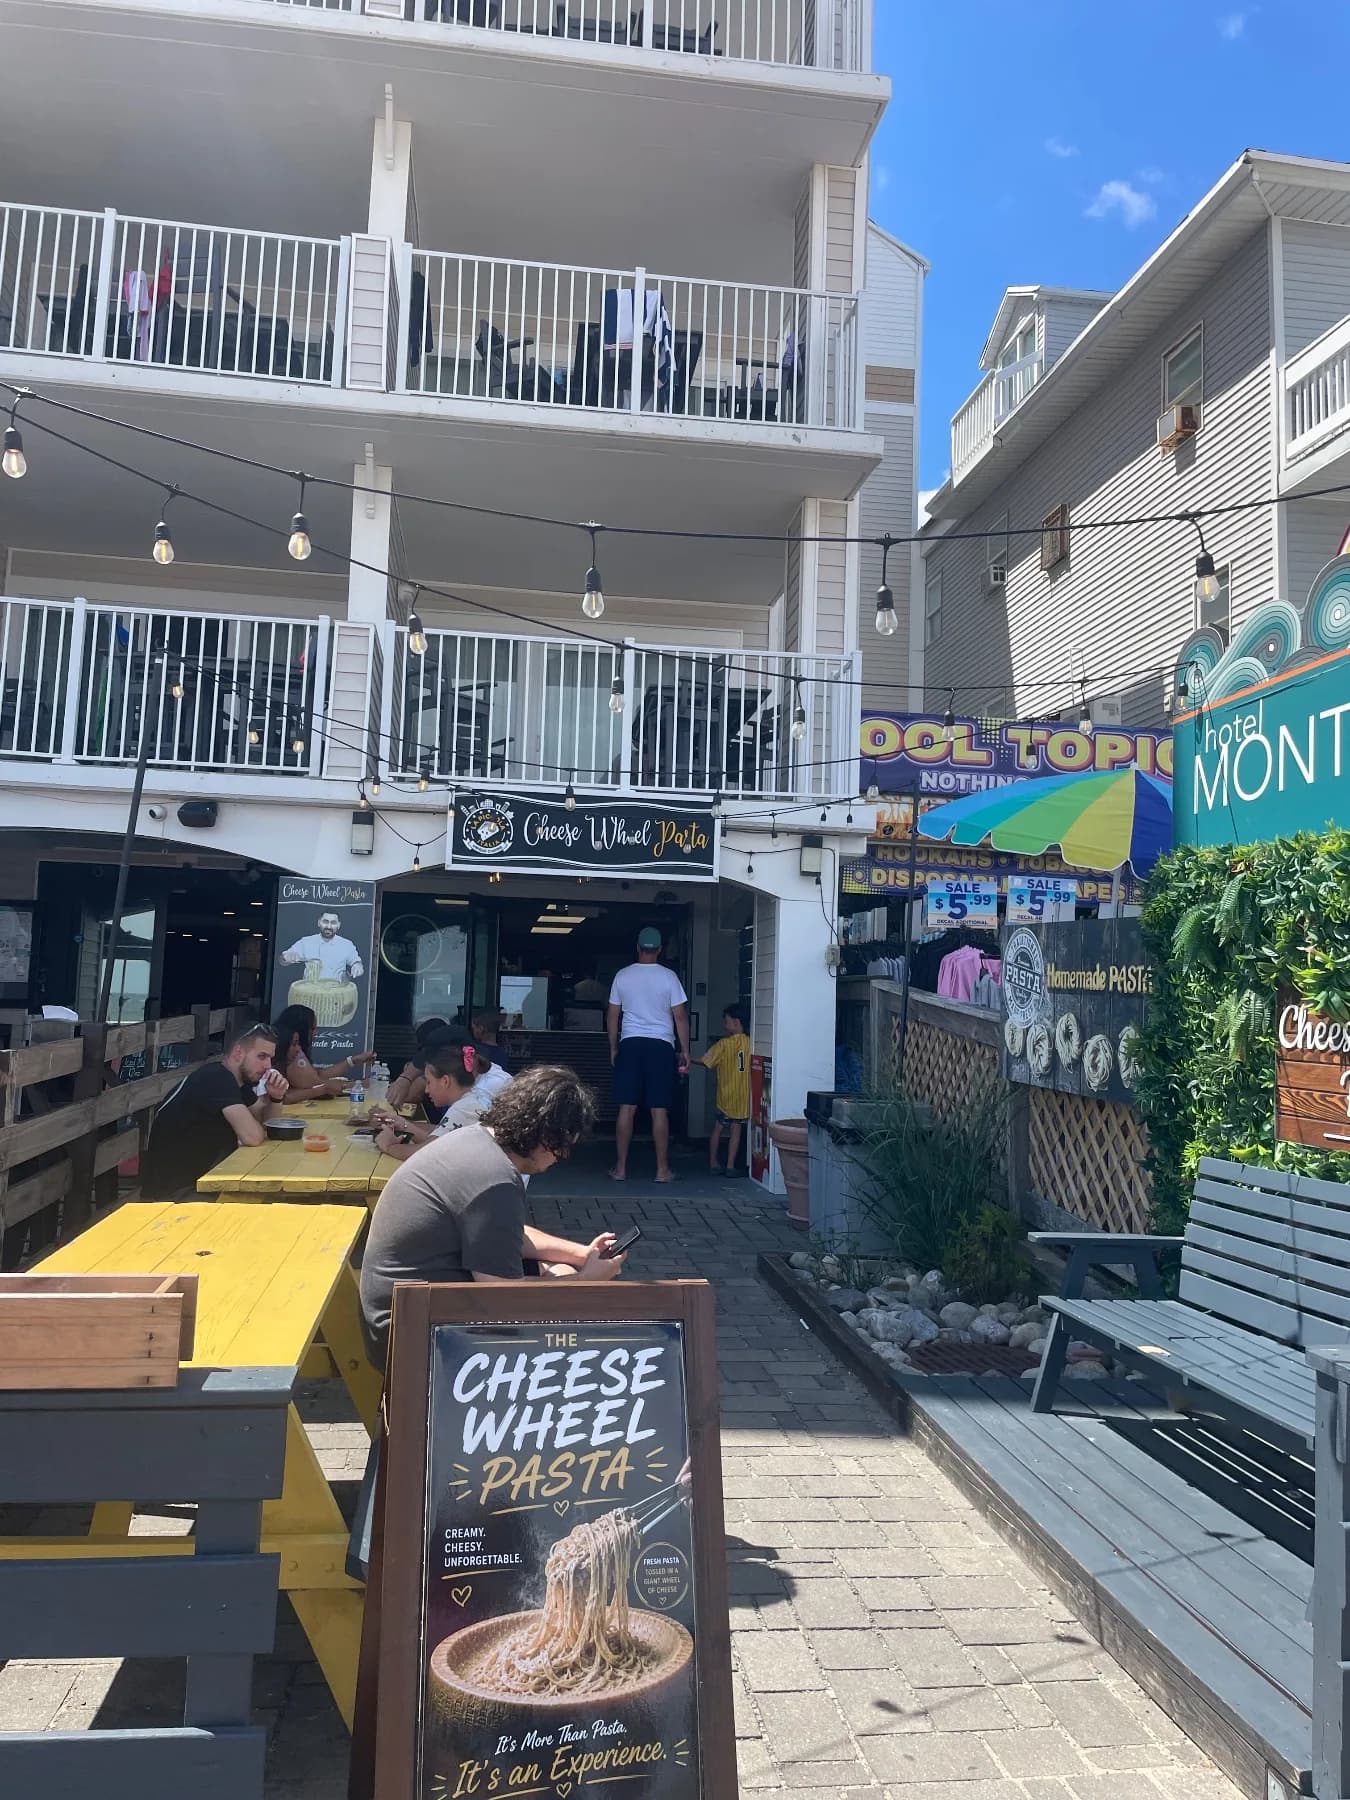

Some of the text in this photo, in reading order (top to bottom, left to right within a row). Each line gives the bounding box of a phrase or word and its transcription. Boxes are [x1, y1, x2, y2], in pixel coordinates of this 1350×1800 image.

[1205, 699, 1263, 753] hotel
[1193, 703, 1350, 815] MONT
[523, 812, 583, 848] Cheese
[282, 883, 366, 902] Cheese Wheel Pasta
[946, 882, 981, 894] SALE
[1027, 879, 1061, 891] SALE
[1006, 964, 1041, 993] PASTA
[1046, 963, 1106, 991] Homemade
[331, 1040, 354, 1049] Pasta
[738, 1051, 745, 1072] 1
[545, 1334, 578, 1347] THE
[452, 1347, 666, 1404] CHEESE
[462, 1397, 657, 1455] WHEEL
[479, 1447, 635, 1505] PASTA
[445, 1527, 486, 1540] CREAMY.
[444, 1541, 485, 1553] CHEESY.
[444, 1553, 523, 1568] UNFORGETTABLE.
[643, 1556, 680, 1566] FRESH PASTA
[643, 1576, 681, 1585] GIANT WHEEL
[647, 1585, 678, 1594] OF CHEESE
[494, 1720, 628, 1756] It's More Than Pasta.
[452, 1740, 668, 1799] It's an Experience.
